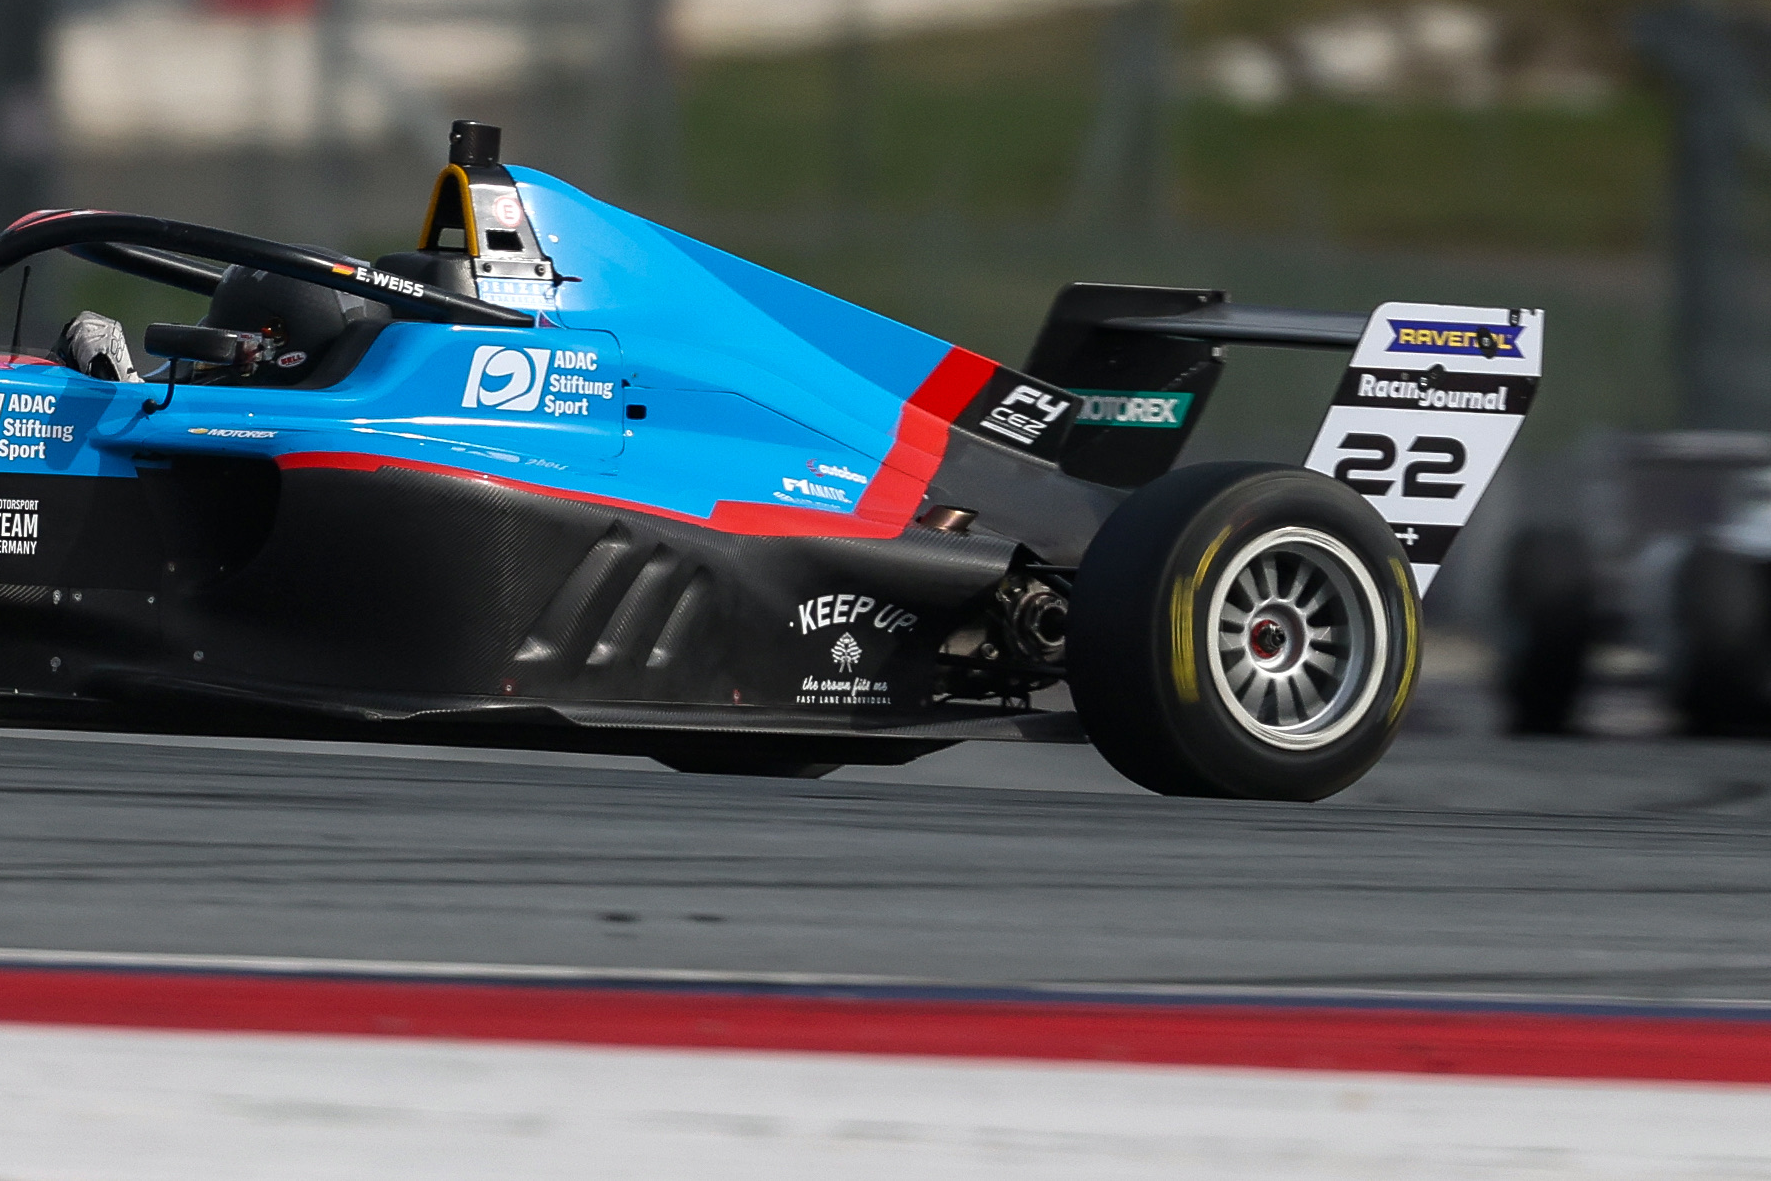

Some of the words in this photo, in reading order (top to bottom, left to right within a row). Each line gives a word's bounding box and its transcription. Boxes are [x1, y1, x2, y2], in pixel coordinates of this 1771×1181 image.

[1398, 328, 1514, 350] RAVENL
[554, 350, 598, 371] ADAC
[549, 374, 614, 400] Stiftung
[1357, 373, 1509, 411] RacinJournal
[7, 394, 57, 415] ADAC
[544, 398, 589, 417] Sport
[1001, 384, 1070, 423] F4
[2, 418, 74, 443] Stiftung
[990, 406, 1048, 436] CEZ
[207, 428, 279, 439] MOTOREX
[1334, 431, 1467, 500] 22
[798, 594, 876, 635] KEEP
[802, 675, 819, 691] the
[796, 695, 816, 705] FAST
[819, 695, 840, 705] LANE
